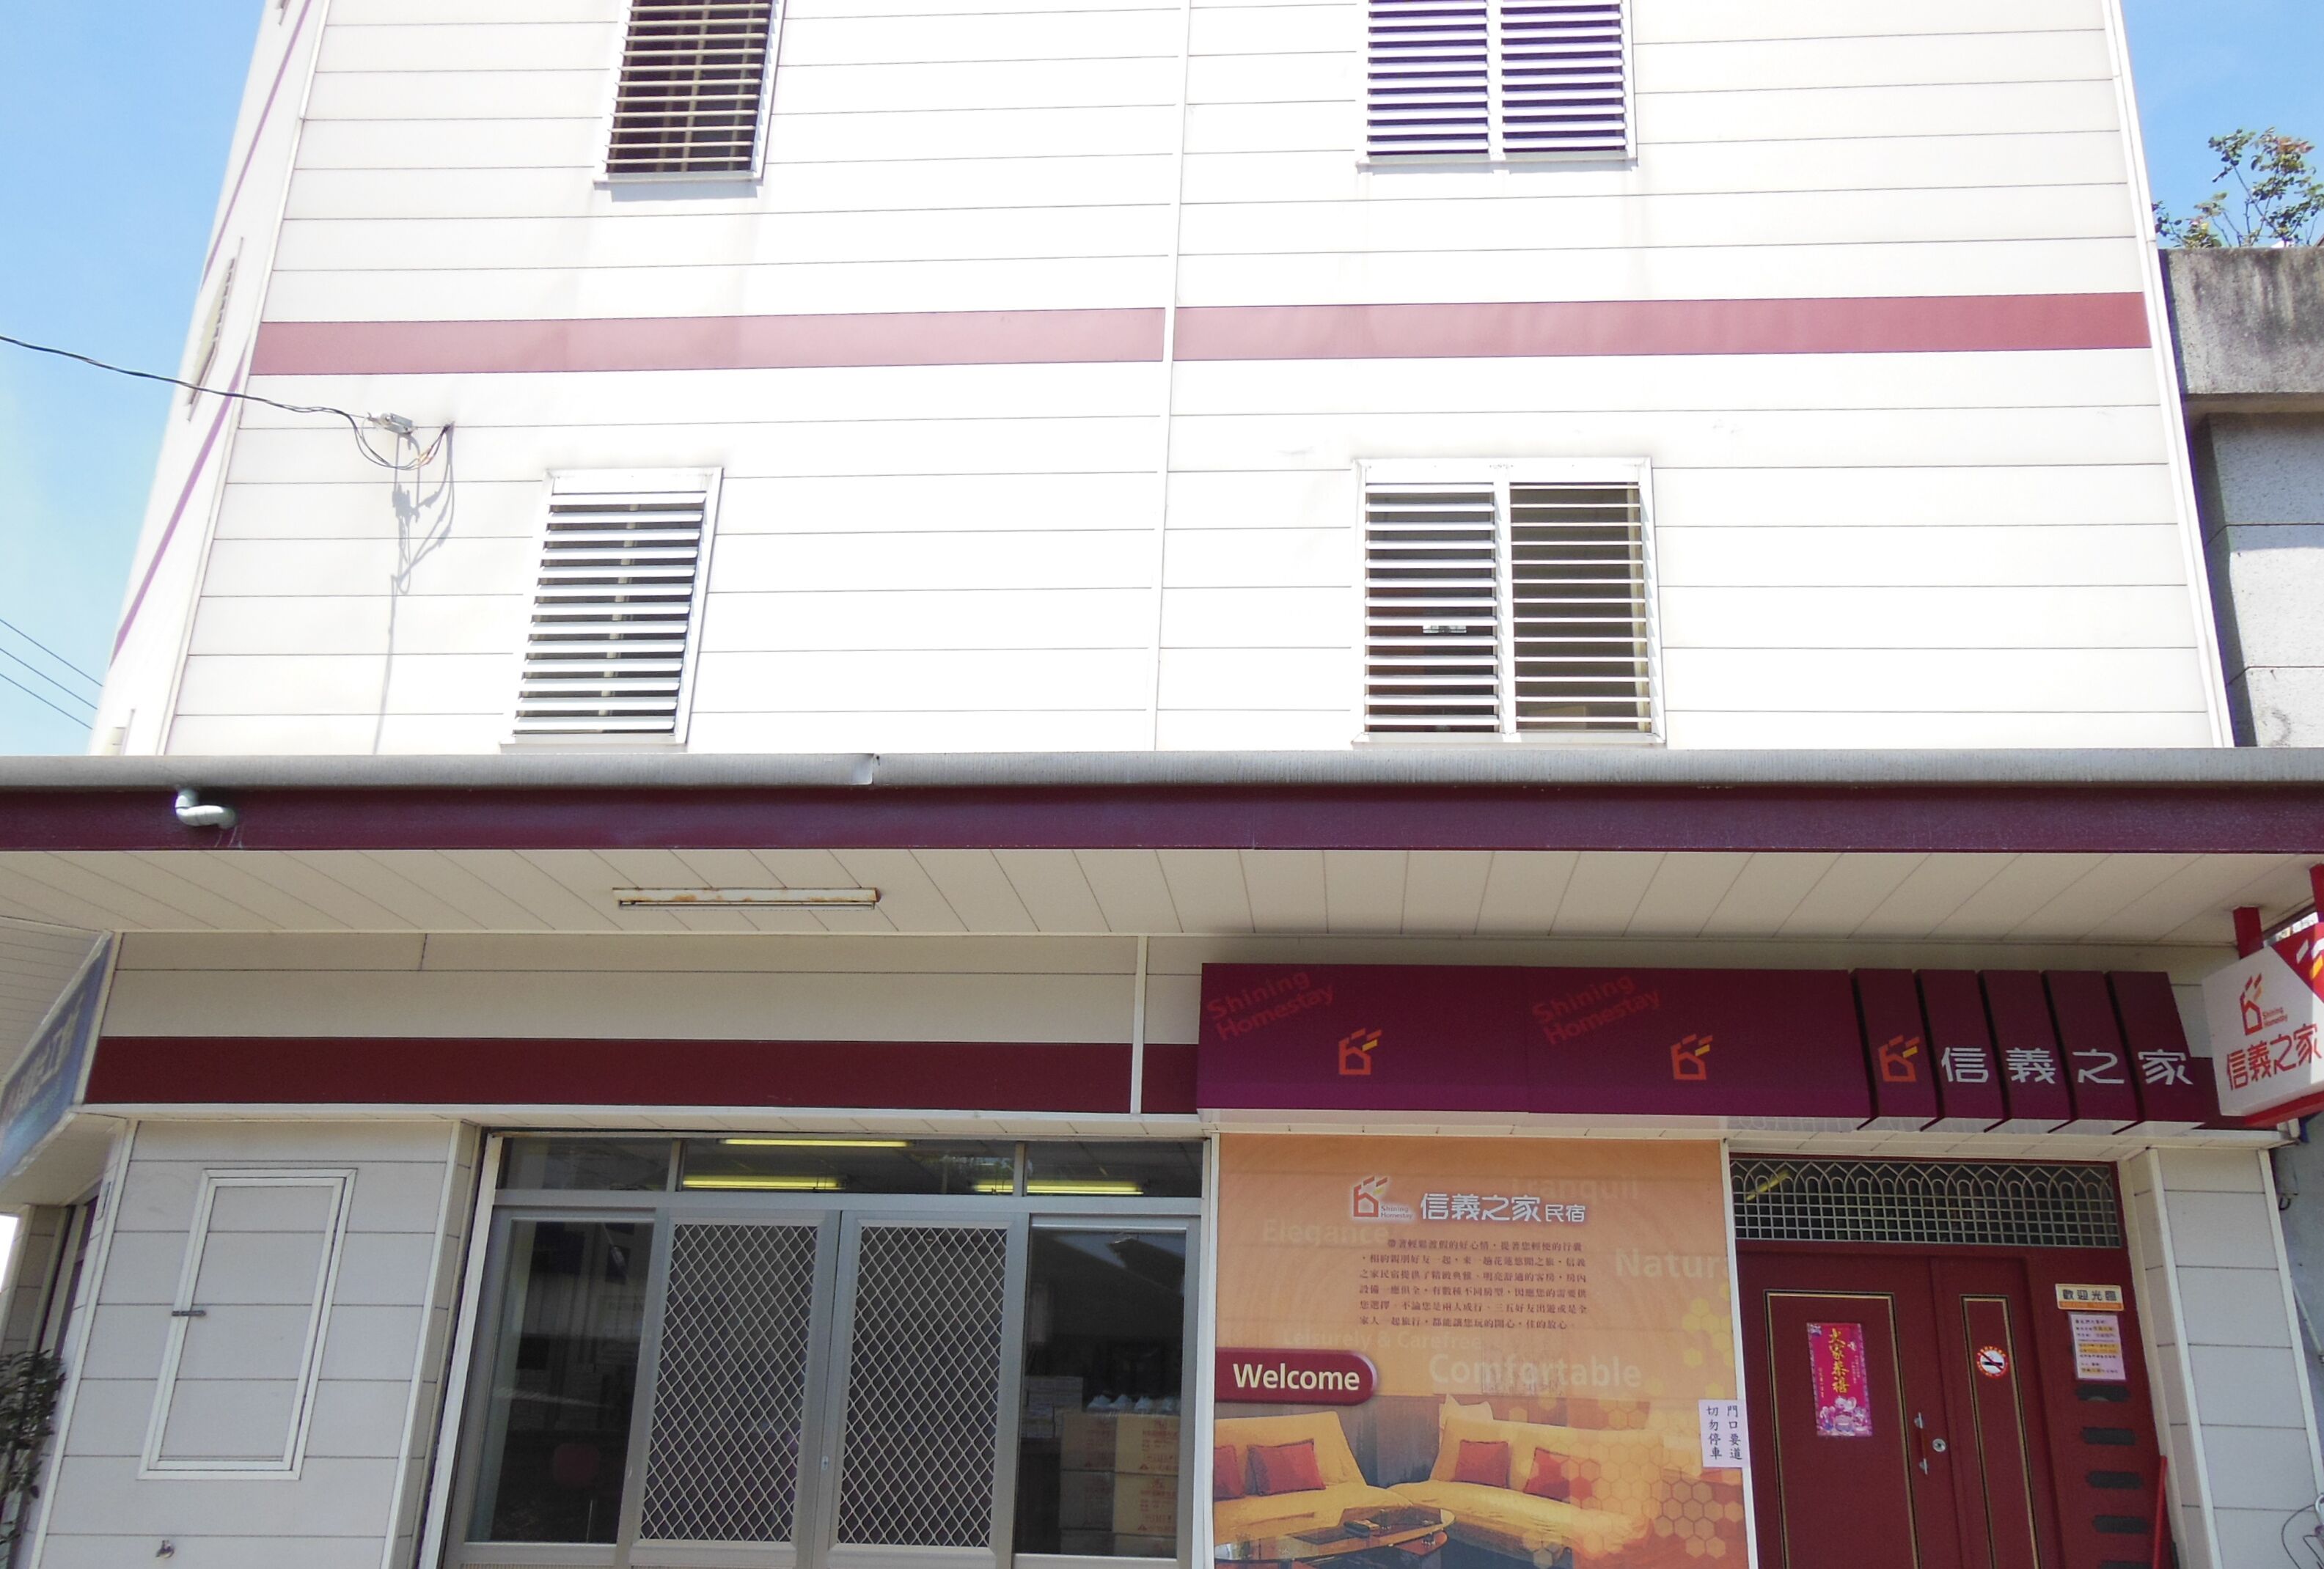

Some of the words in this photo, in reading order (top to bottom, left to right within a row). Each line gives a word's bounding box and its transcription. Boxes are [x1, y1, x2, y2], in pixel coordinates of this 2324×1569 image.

[1206, 971, 1311, 1021] Shining
[1217, 985, 1334, 1041] Homestay
[1532, 975, 1636, 1024] Shining
[1543, 991, 1660, 1045] Homestay
[1941, 1046, 2193, 1086] 信義之家
[2226, 1023, 2323, 1091] 信義之家
[1420, 1193, 1586, 1223] 信義之家民宿
[1262, 1220, 1390, 1245] Elegance
[1615, 1247, 1729, 1279] Natur
[1377, 1330, 1391, 1347] &
[1397, 1330, 1483, 1351] Carefree
[1234, 1363, 1360, 1391] Welcome
[1429, 1352, 1643, 1389] Comfortable
[1707, 1405, 1723, 1460] 切勿停車
[1726, 1405, 1743, 1460] 門口要道
